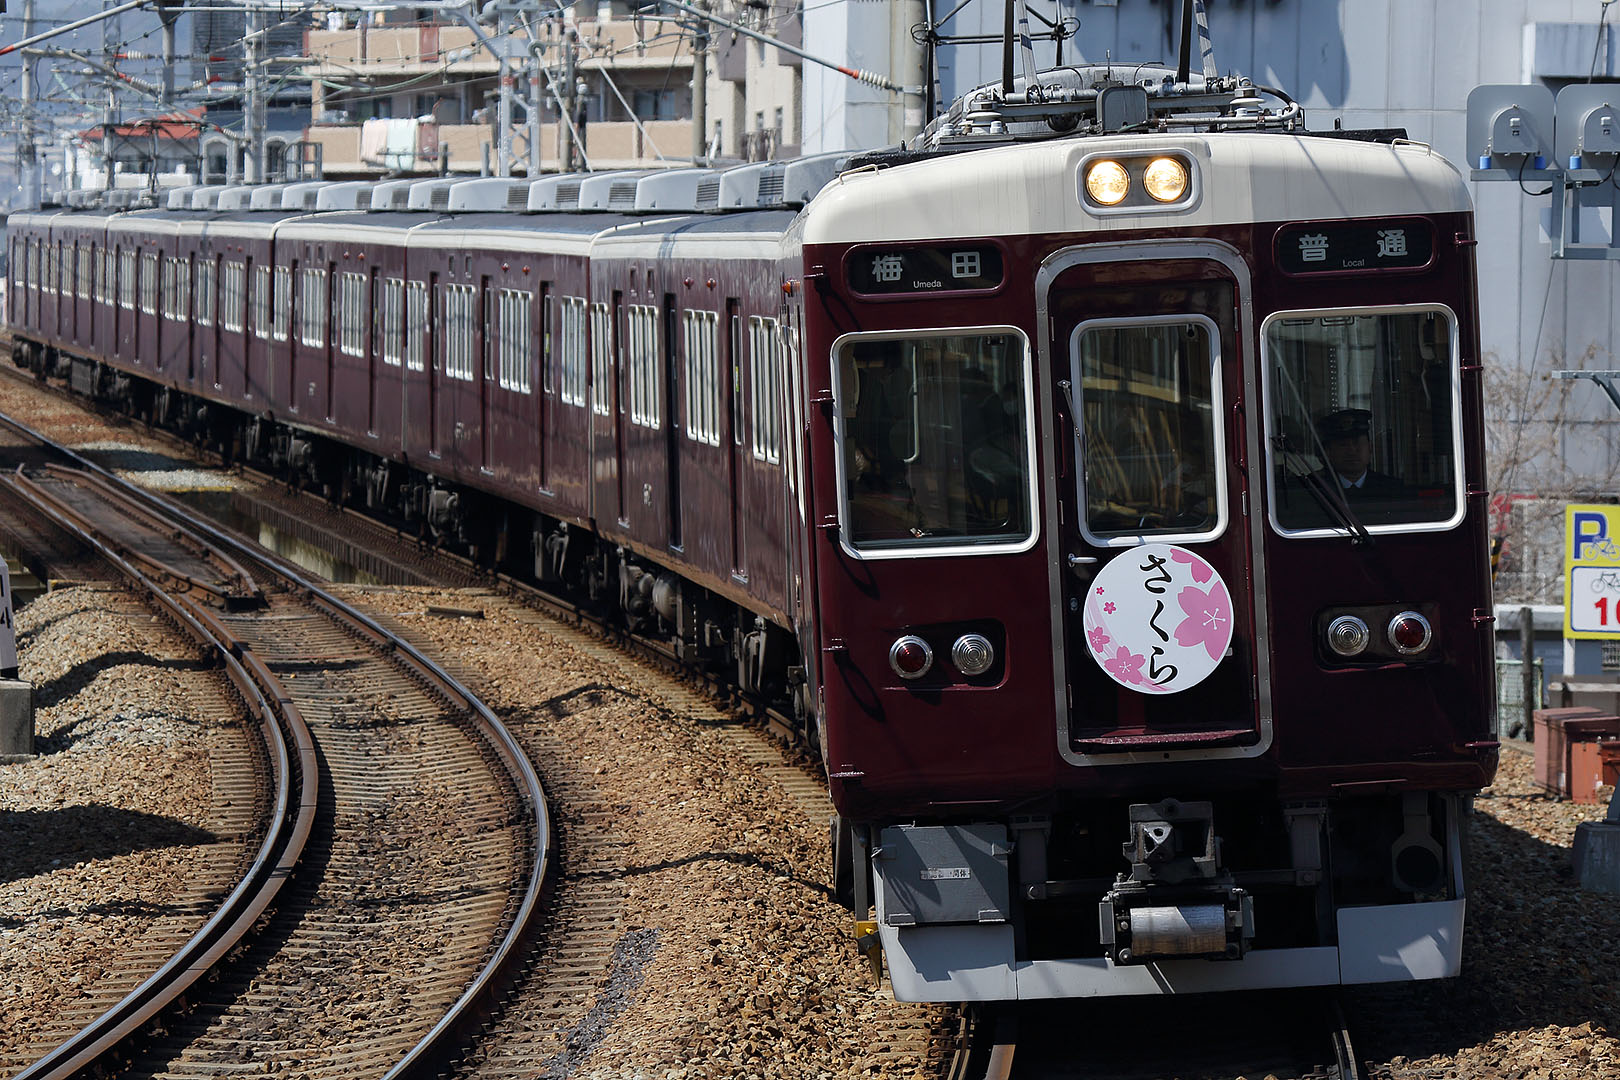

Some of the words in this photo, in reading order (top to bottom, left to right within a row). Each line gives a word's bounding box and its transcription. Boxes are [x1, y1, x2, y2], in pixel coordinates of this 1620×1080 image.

[1299, 229, 1408, 262] 普通
[871, 251, 981, 283] 梅田
[1342, 258, 1365, 268] Local
[913, 279, 942, 289] Umeda
[1574, 512, 1607, 559] P
[1139, 554, 1178, 686] さくら
[1594, 597, 1620, 626] 1
